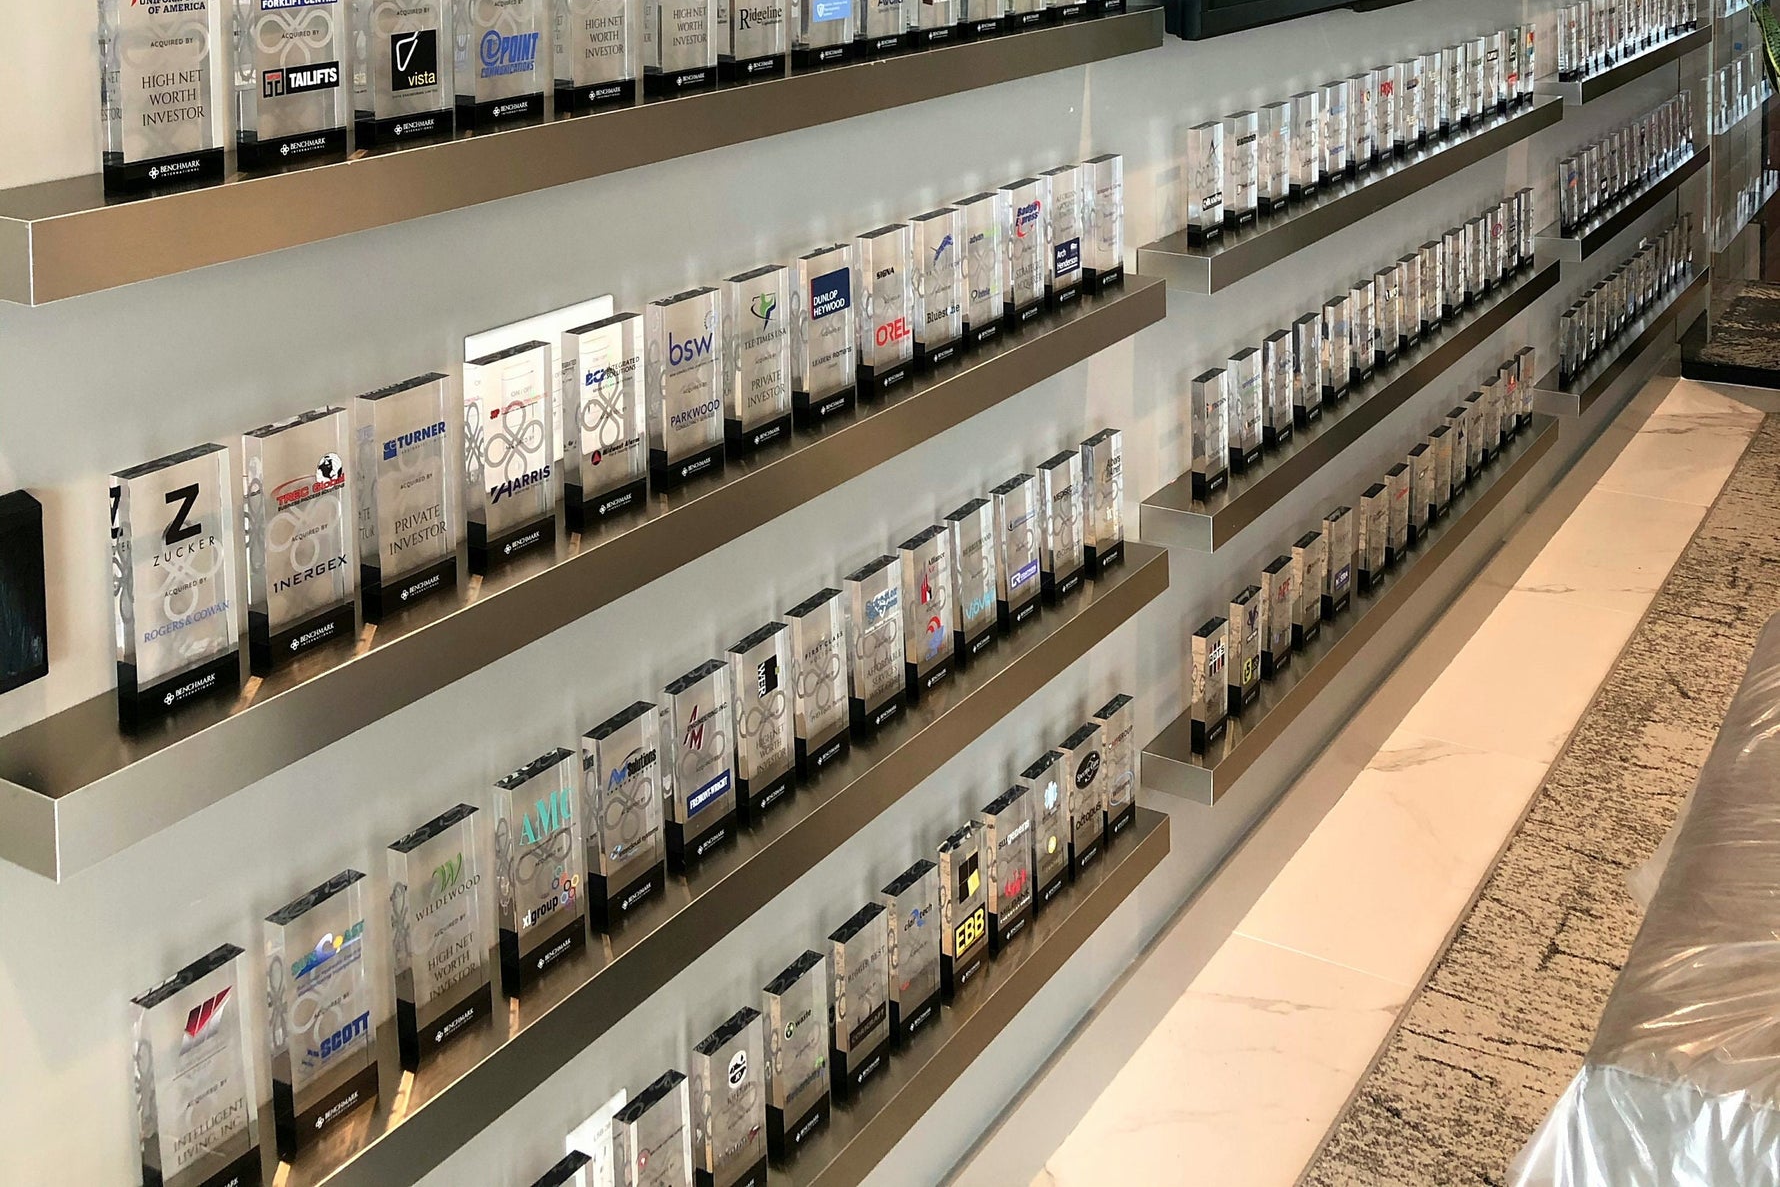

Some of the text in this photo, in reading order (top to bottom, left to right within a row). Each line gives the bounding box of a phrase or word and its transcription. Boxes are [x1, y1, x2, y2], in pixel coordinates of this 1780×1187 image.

[148, 2, 206, 14] OF AMERICA
[673, 6, 707, 20] HIGH NET
[739, 6, 782, 30] Ridgeline
[585, 16, 624, 30] HIGH NET
[677, 21, 703, 32] WORTH
[151, 39, 181, 48] ACQUIRED
[281, 31, 311, 39] ACQUIRED
[590, 31, 619, 43] WORTH
[673, 33, 707, 46] INVESTOR
[585, 46, 624, 59] INVESTOR
[142, 69, 203, 89] HIGH NET
[289, 67, 337, 88] TAILIFTS
[408, 71, 435, 86] vista
[150, 89, 196, 106] WORTH
[500, 102, 528, 112] BENCHMARK
[142, 106, 205, 126] INVESTOR
[403, 119, 434, 130] BENCHMARK
[290, 138, 325, 150] BENCHMARK
[160, 160, 200, 172] BENCHMARK
[813, 298, 845, 317] HEYWOOD
[814, 289, 838, 306] DUNLOP
[876, 316, 910, 346] OREL
[669, 332, 712, 366] bsw
[751, 370, 781, 391] PRIVATE
[747, 385, 785, 408] INVESTOR
[671, 399, 720, 427] PARKWOOD
[398, 421, 446, 449] TURNER
[400, 475, 425, 490] ACQUIRED
[606, 493, 632, 509] BENCHMARK
[165, 483, 202, 546] Z
[394, 504, 440, 535] PRIVATE
[292, 527, 319, 542] ACQUIRED
[389, 521, 446, 556] INVESTOR
[512, 531, 540, 548] BENCHMARK
[153, 535, 215, 566] ZUCKER
[164, 577, 207, 597] ACQUIRED BY
[409, 574, 440, 594] BENCHMARK
[144, 618, 184, 643] ROGERS
[194, 600, 229, 622] COWAN
[300, 622, 334, 643] BENCHMARK
[805, 631, 843, 660] FIRST CLASS
[175, 673, 215, 697] BENCHMARK
[628, 748, 656, 776] Solutions
[415, 874, 481, 922] WILDEWOOD
[956, 908, 985, 959] EBB
[428, 931, 474, 971] HIGH NET
[544, 937, 571, 963] BENCHMARK
[433, 951, 470, 982] WORTH
[429, 962, 476, 1002] INVESTOR
[444, 1007, 474, 1036] BENCHMARK
[320, 1010, 369, 1058] SCOTT
[324, 1091, 359, 1120] BENCHMARK
[174, 1097, 245, 1153] INTELLIGENT
